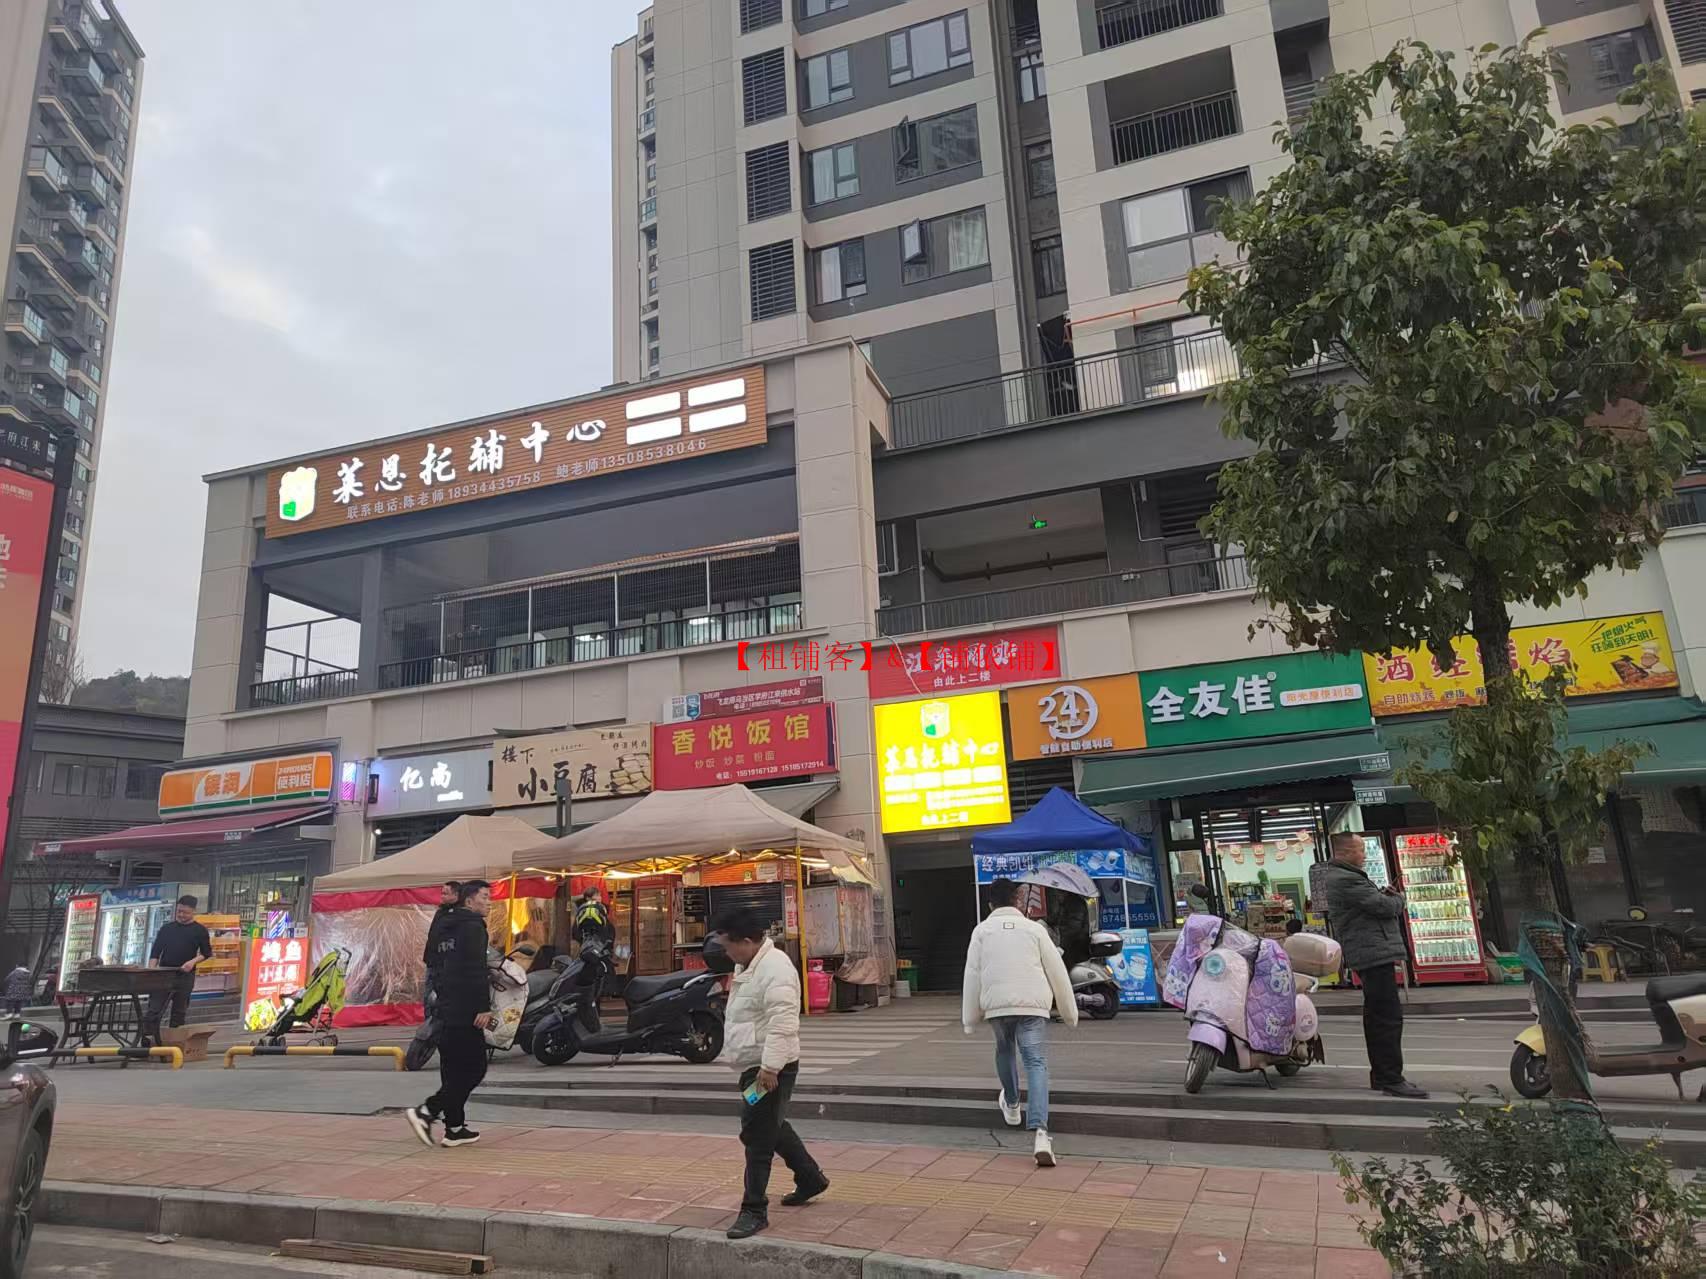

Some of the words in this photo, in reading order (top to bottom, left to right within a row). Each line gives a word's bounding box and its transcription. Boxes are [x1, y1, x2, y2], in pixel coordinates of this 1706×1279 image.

[331, 418, 606, 505] 莱恩托辅中心
[447, 471, 541, 500] 18934435758
[934, 671, 991, 688] 由此上二楼
[1147, 674, 1275, 724] 全友佳
[672, 713, 810, 756] 香悦饭馆
[501, 745, 535, 765] 楼下
[694, 757, 716, 769] 炒饭
[277, 773, 311, 790] 便利店
[517, 760, 598, 802] 小豆腐
